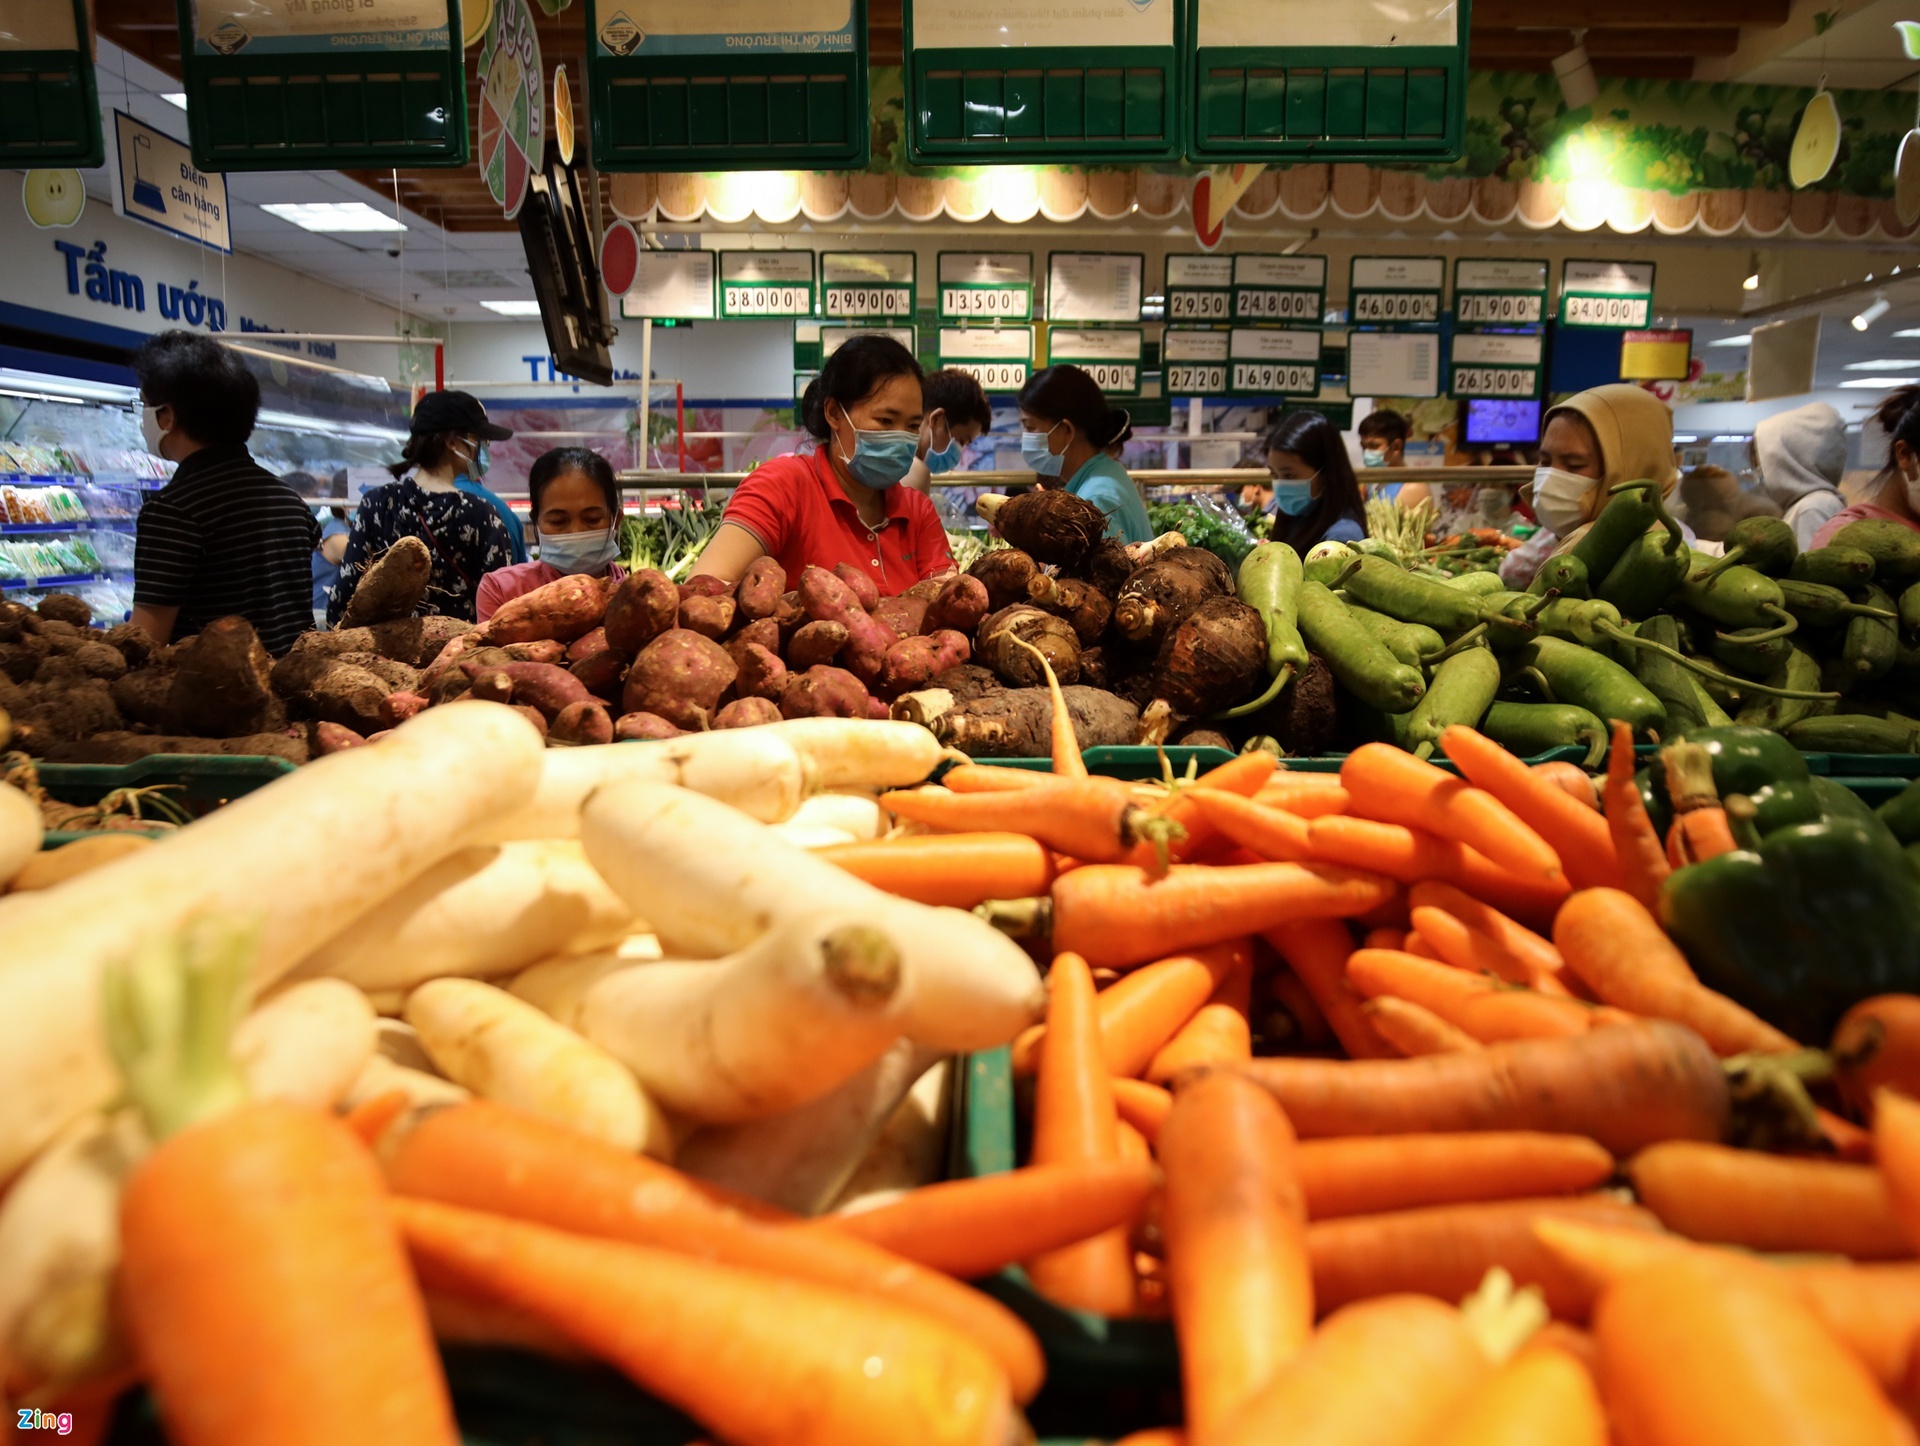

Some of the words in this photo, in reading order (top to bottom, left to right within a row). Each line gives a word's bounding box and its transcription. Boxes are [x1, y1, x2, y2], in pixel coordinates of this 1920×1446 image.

[726, 34, 779, 48] TRƯỜNG
[823, 34, 852, 47] BÌNH
[171, 186, 192, 206] cân
[194, 193, 220, 221] hàng
[55, 240, 144, 313] Tẩm
[158, 280, 227, 333] ướp
[728, 290, 792, 307] 38.000
[829, 292, 895, 309] 29.900
[947, 292, 1010, 310] 13.500
[1174, 296, 1231, 314] 29.50
[1240, 293, 1303, 314] 24.800
[1358, 297, 1420, 316] 46.000
[1461, 298, 1527, 317] 71.900
[1571, 300, 1630, 318] 34.000
[961, 367, 1022, 384] 0.000
[1171, 370, 1226, 388] 27.20
[1237, 368, 1298, 387] 16.900
[1457, 372, 1520, 390] 26.500
